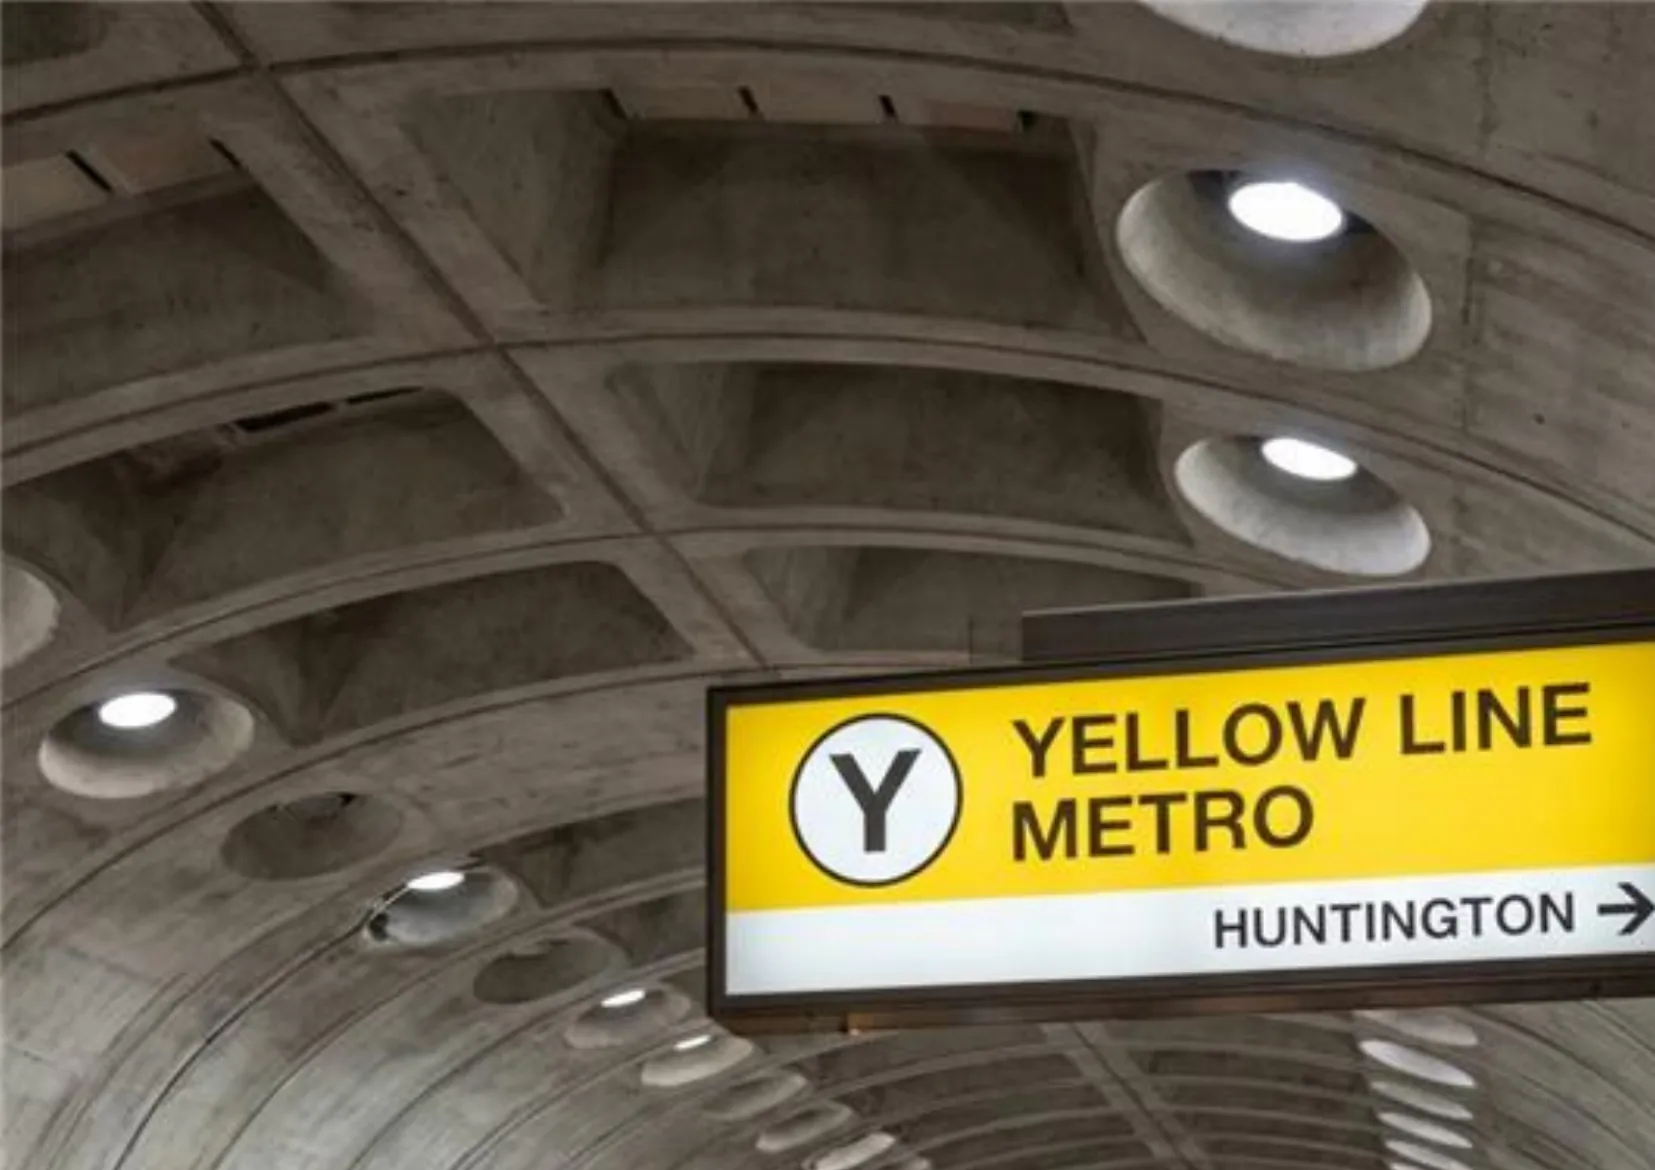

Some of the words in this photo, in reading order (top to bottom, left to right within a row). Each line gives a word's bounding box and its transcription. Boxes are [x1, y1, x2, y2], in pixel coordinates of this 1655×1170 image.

[1013, 698, 1367, 778] YELLOW
[1400, 682, 1593, 756] LINE
[830, 749, 921, 852] Y
[1012, 784, 1314, 862] METRO
[1213, 892, 1574, 949] HUNTINGTON
